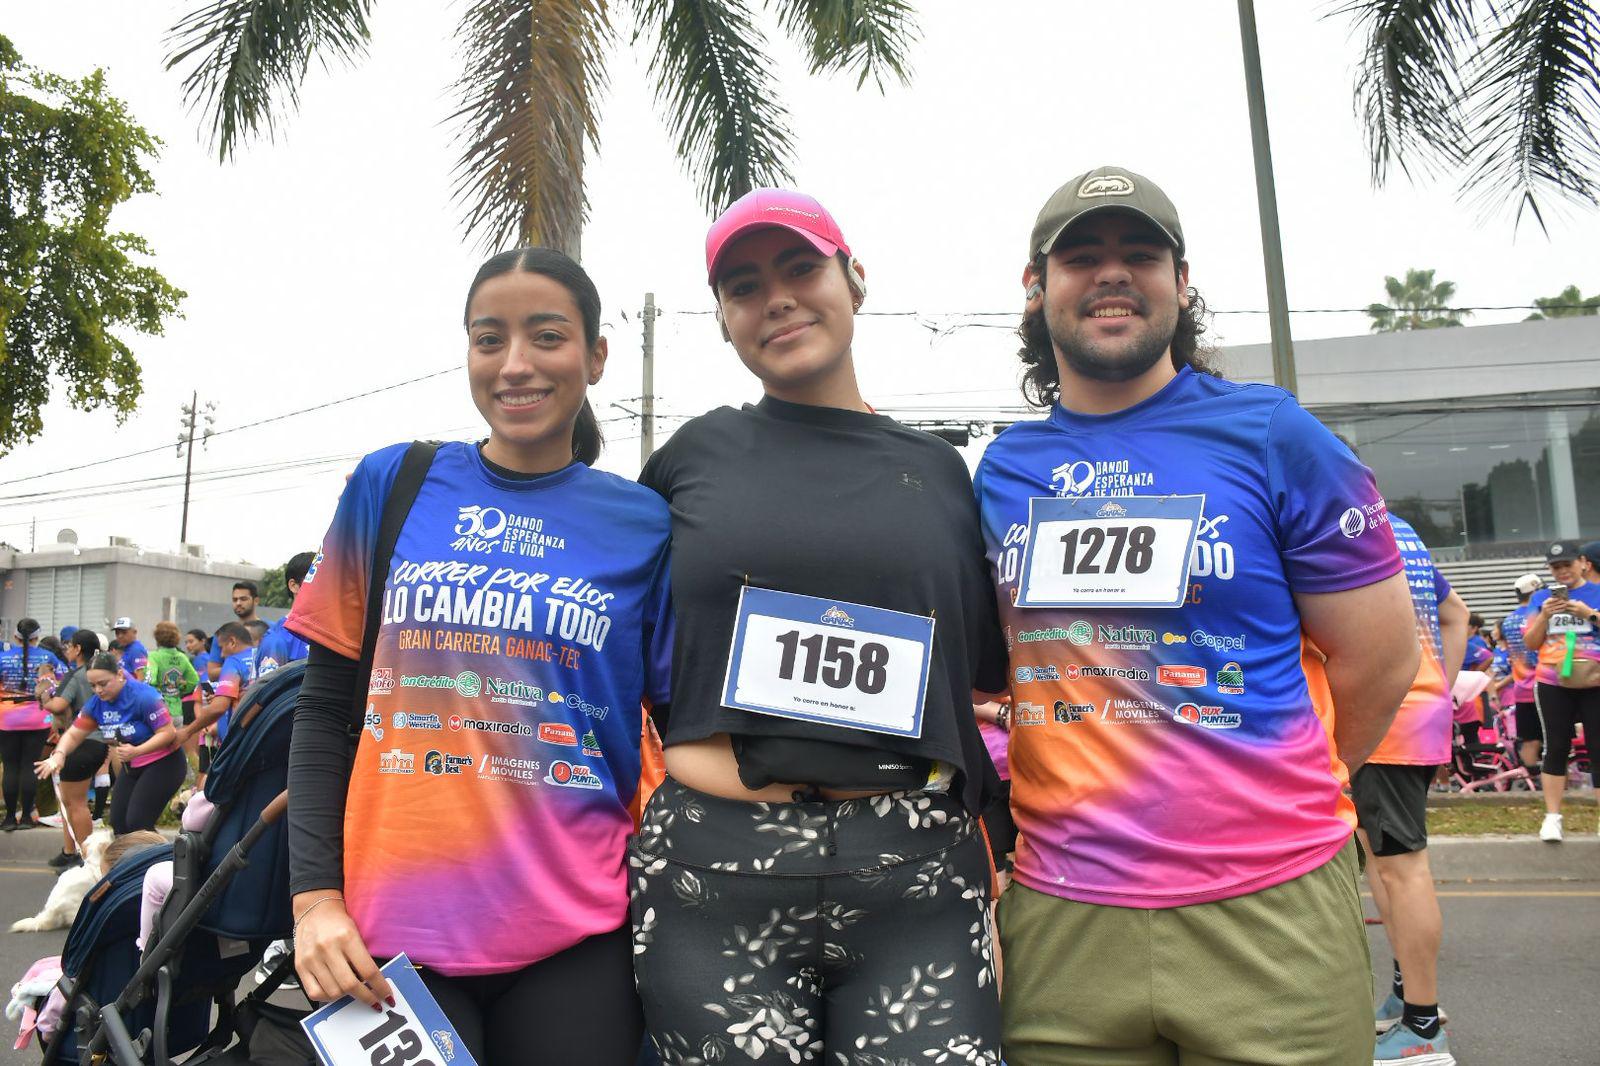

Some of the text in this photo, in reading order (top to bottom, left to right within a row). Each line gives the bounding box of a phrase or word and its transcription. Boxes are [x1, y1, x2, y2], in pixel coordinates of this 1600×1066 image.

[1095, 460, 1129, 475] DANDO
[1094, 472, 1154, 489] ESPERANZA
[507, 514, 543, 532] DANDO
[449, 535, 501, 555] AÑOS
[502, 539, 544, 559] DE VIDA
[504, 527, 565, 550] ESPERANZA
[1060, 525, 1156, 575] 1278
[1190, 540, 1235, 580] DO
[997, 547, 1018, 585] LO
[394, 561, 615, 611] CORRER POR ELLOS
[383, 583, 612, 653] LO CAMBIA TODO
[1098, 624, 1157, 643] Nativa
[1190, 629, 1246, 652] Coppel
[399, 629, 581, 671] GRAN CARRERA GANAC-TEC
[776, 630, 889, 695] 1158
[1081, 666, 1149, 681] maxiradio
[485, 676, 544, 701] Nativa
[829, 701, 848, 710] honor
[1200, 705, 1221, 716] BUX
[463, 718, 533, 736] maxiradio
[1200, 715, 1239, 724] PUNTUAL
[358, 1010, 436, 1066] 13
